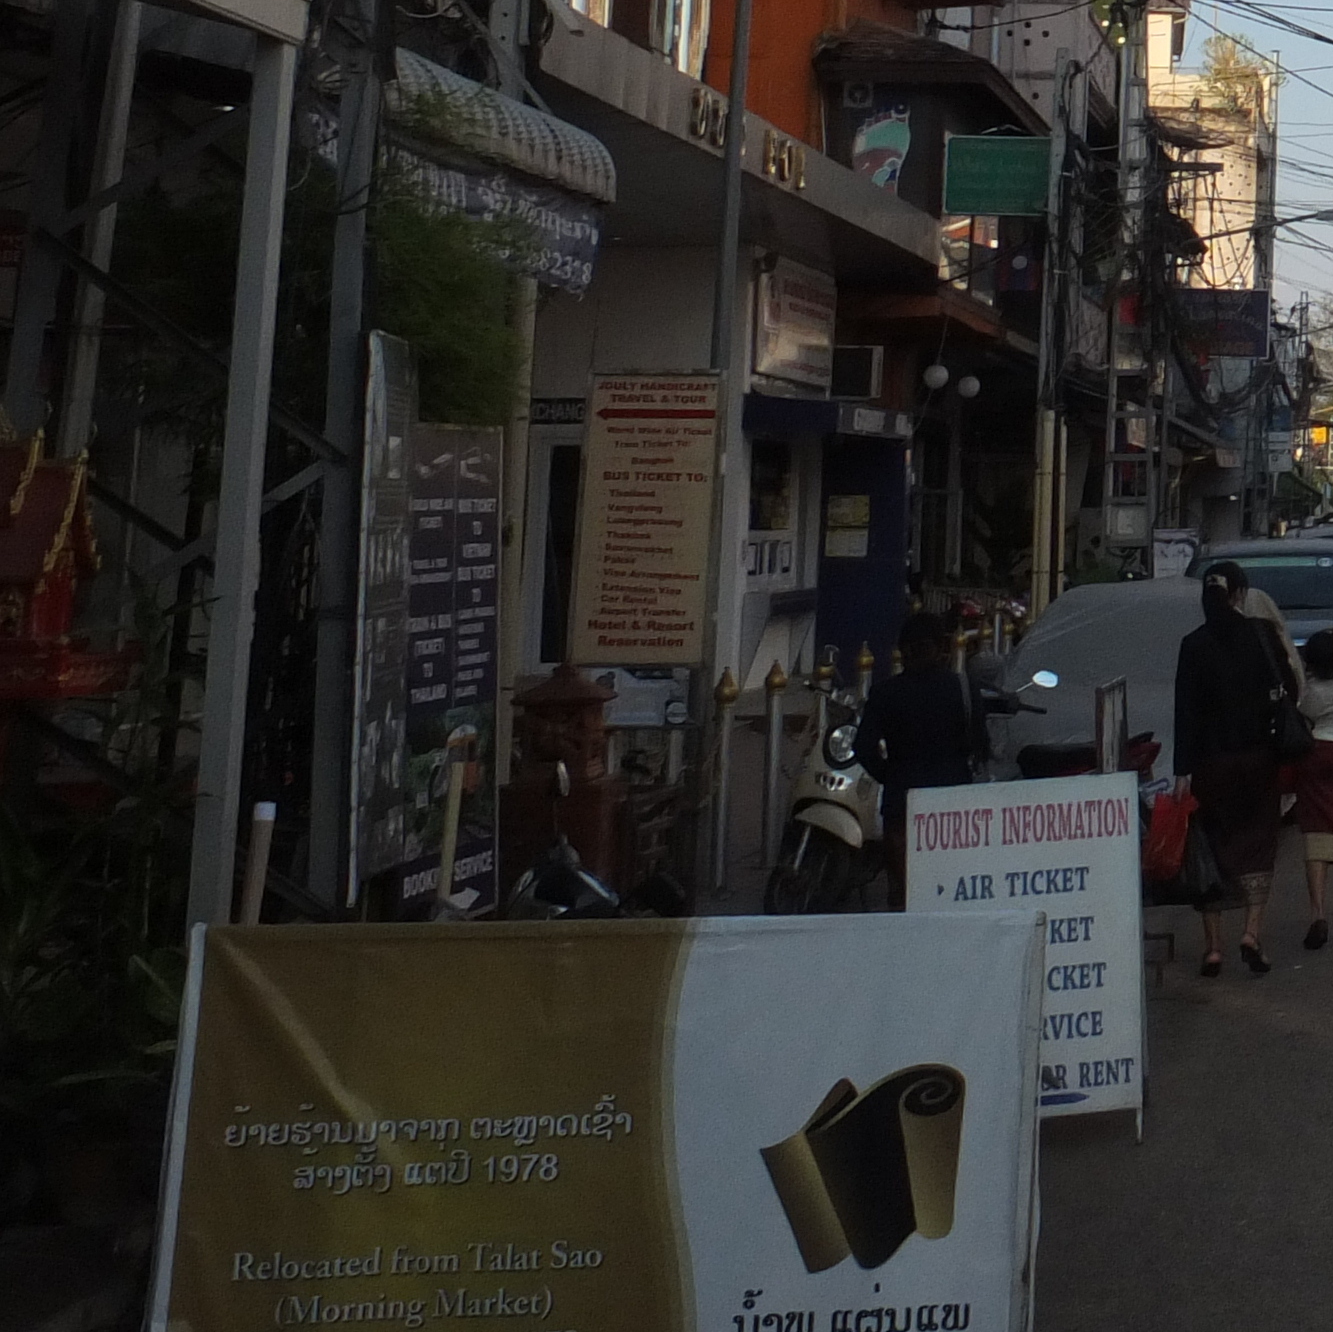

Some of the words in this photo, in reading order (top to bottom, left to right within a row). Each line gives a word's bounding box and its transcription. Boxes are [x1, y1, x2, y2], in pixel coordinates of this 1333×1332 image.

[611, 394, 657, 403] TRAVEL
[673, 395, 708, 404] TOUR
[603, 471, 630, 481] BUS
[634, 471, 682, 482] TICKET
[686, 472, 708, 482] TO:
[609, 488, 656, 497] Thailand
[603, 568, 627, 576] Visa
[601, 594, 620, 603] Car
[588, 619, 627, 631] Hotel
[631, 620, 642, 630] &
[647, 620, 694, 631] Resort
[597, 635, 684, 647] Reservation
[914, 808, 993, 851] TOURIST
[1001, 798, 1129, 846] INFORMATION
[454, 849, 493, 881] SERVICE
[954, 872, 996, 902] AIR
[1004, 866, 1091, 899] TICKET
[1048, 915, 1095, 946] KET
[1046, 961, 1107, 991] CKET
[1041, 1009, 1105, 1042] RVICE
[1078, 1057, 1135, 1088] RENT
[483, 1154, 560, 1185] 1978
[231, 1245, 382, 1283] Relocated
[389, 1245, 460, 1275] from
[467, 1241, 542, 1272] Talat
[548, 1239, 604, 1270] Sao
[274, 1291, 426, 1329] (Morning
[431, 1283, 555, 1321] Market)
